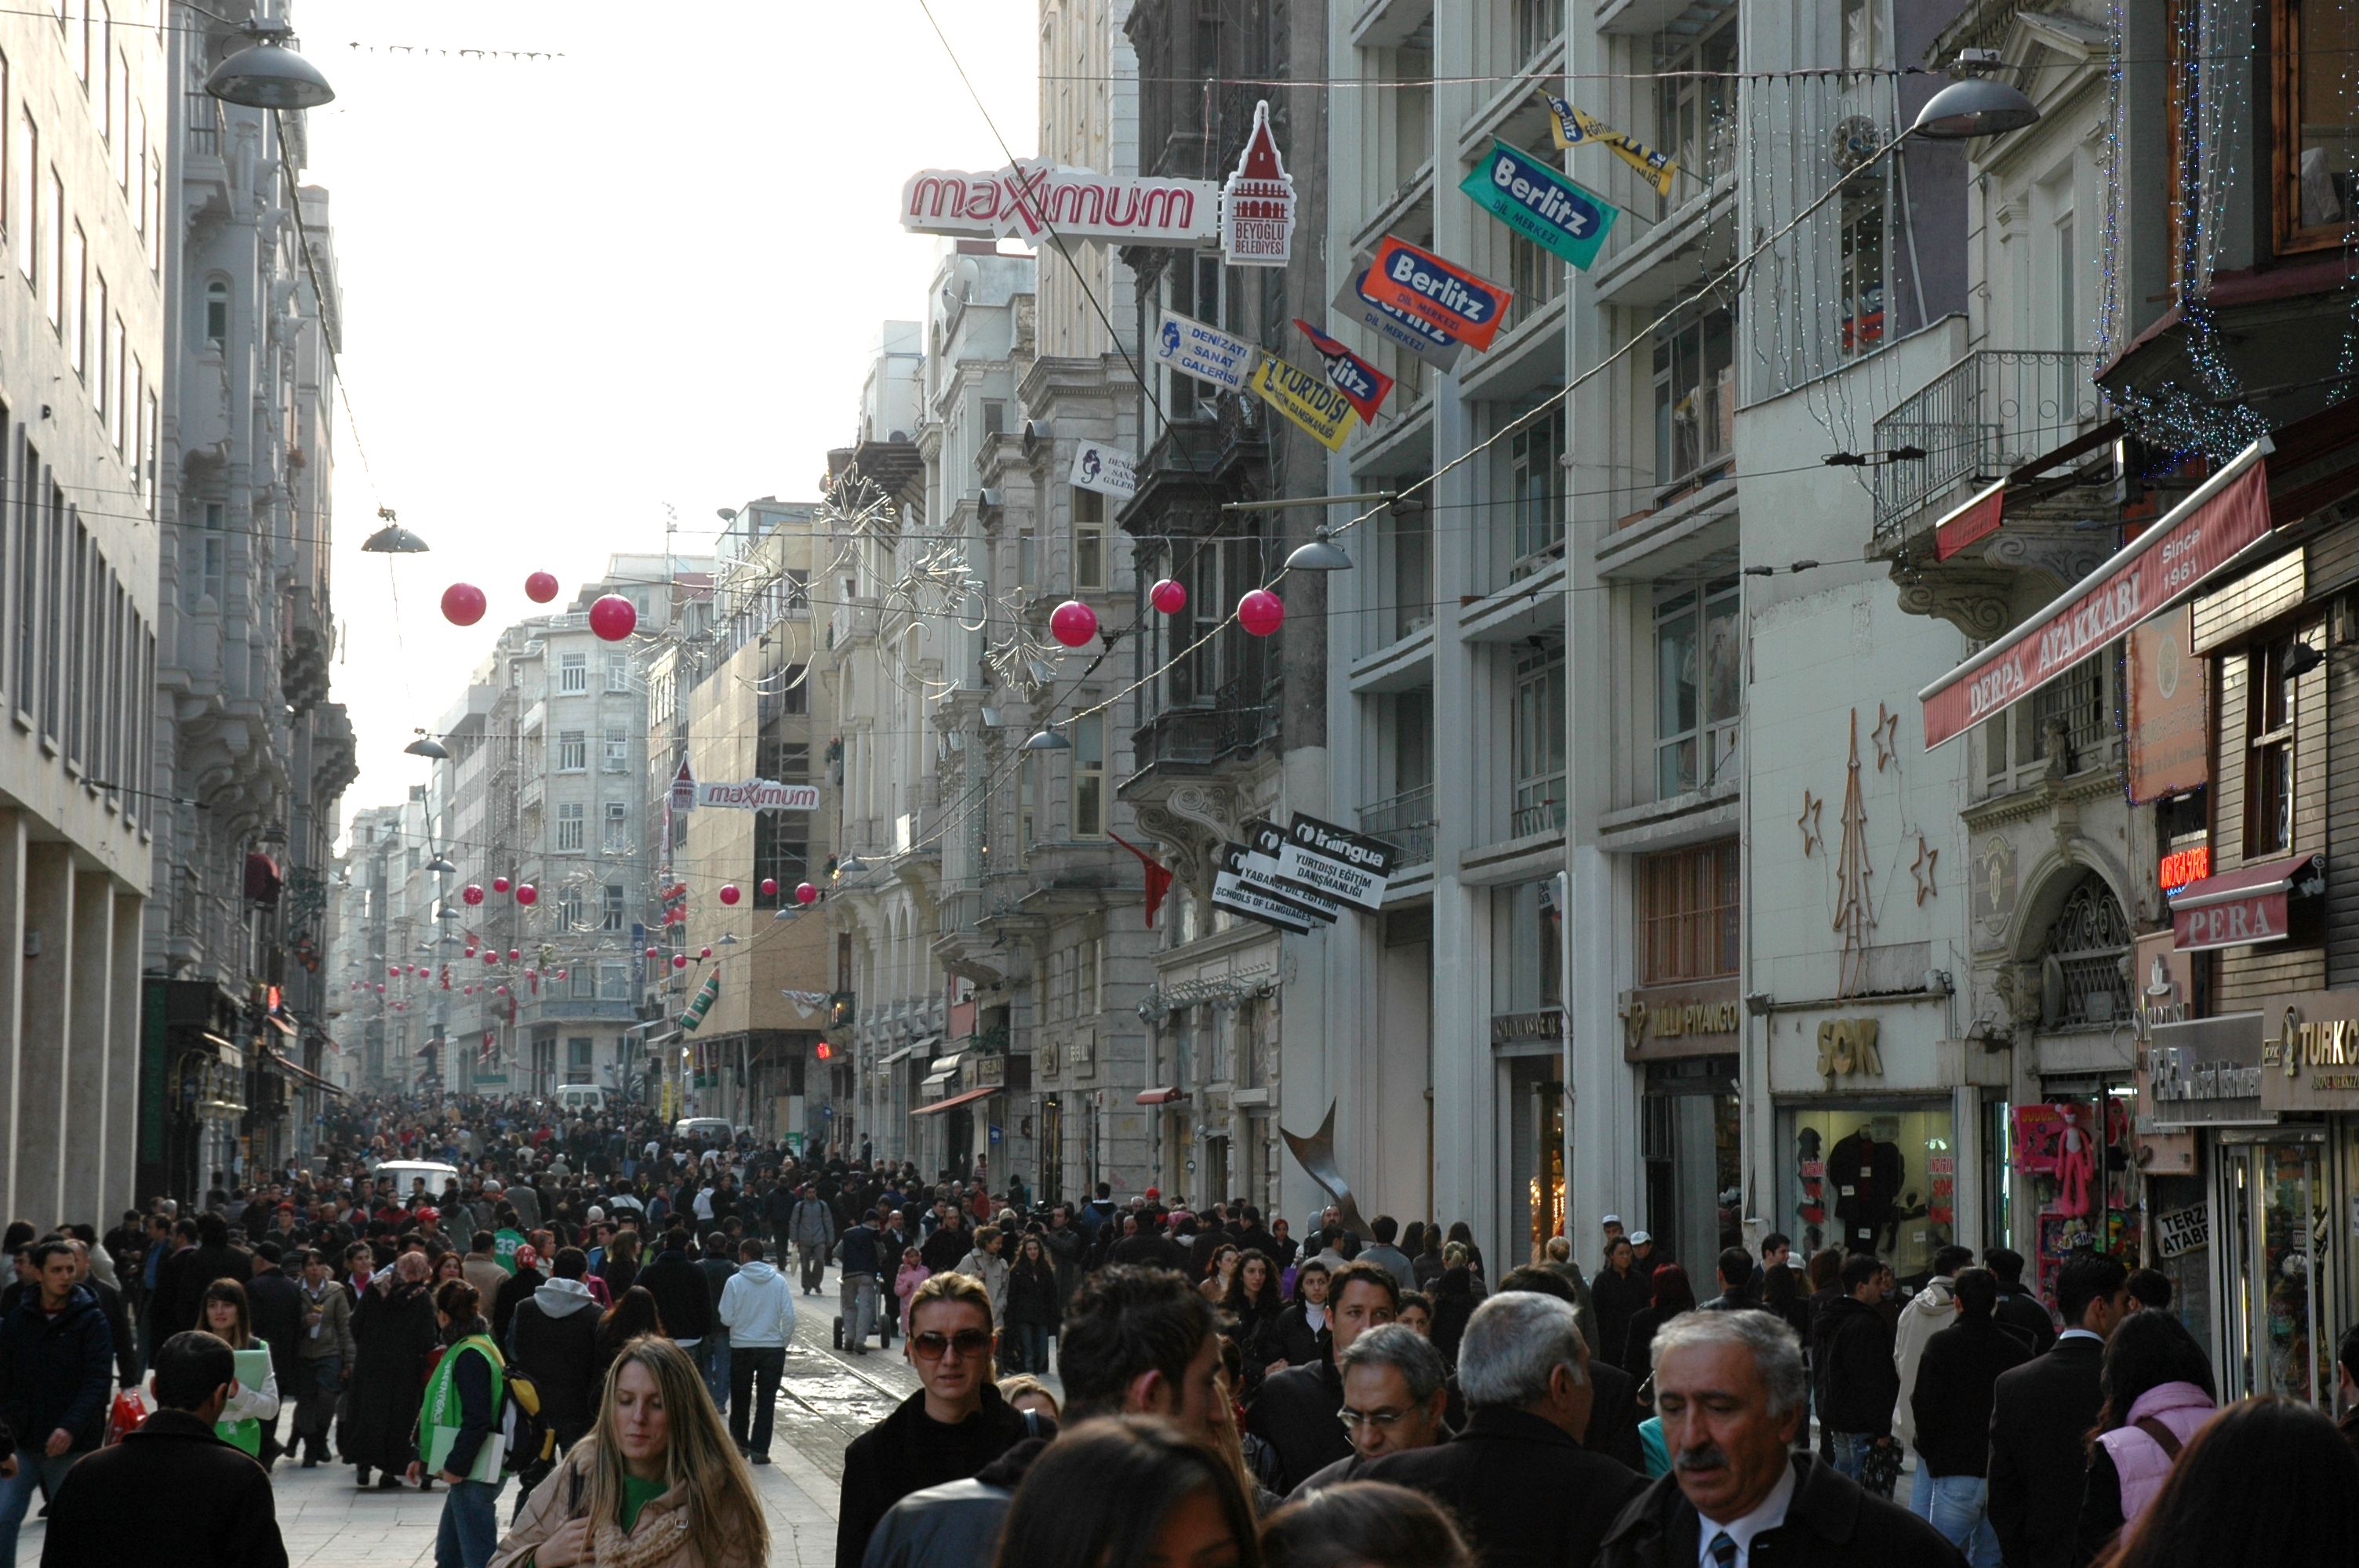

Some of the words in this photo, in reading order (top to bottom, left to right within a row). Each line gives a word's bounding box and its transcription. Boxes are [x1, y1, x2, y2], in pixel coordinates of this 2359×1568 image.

[1493, 200, 1509, 216] DİL
[1494, 156, 1588, 236] Berlitz
[1235, 220, 1285, 241] BEYOĞLU
[1235, 239, 1285, 256] BELEDİYESİ
[1392, 254, 1485, 321] Berlitz
[1191, 328, 1248, 358] DENİZATI
[1365, 312, 1379, 328] DİL
[1383, 323, 1426, 352] MERKEZİ
[1194, 346, 1235, 368] SANAT
[1279, 364, 1351, 424] YURTDIŞI
[2161, 525, 2201, 564] Since
[2163, 557, 2197, 593] 1961
[1969, 653, 2026, 720] DERPA
[2037, 572, 2141, 675] AYAKKABI
[1296, 853, 1337, 878] YURTDIŞI
[1339, 868, 1372, 889] EĞİTİM
[1297, 866, 1363, 898] DANIŞMANLIĞI
[1216, 886, 1252, 904] SCHOOLS
[1253, 898, 1263, 908] OF
[1265, 901, 1312, 923] LANGUAGES
[2187, 902, 2272, 945] PERA
[1685, 997, 1739, 1034] PİYANGO
[496, 1238, 516, 1256] 33
